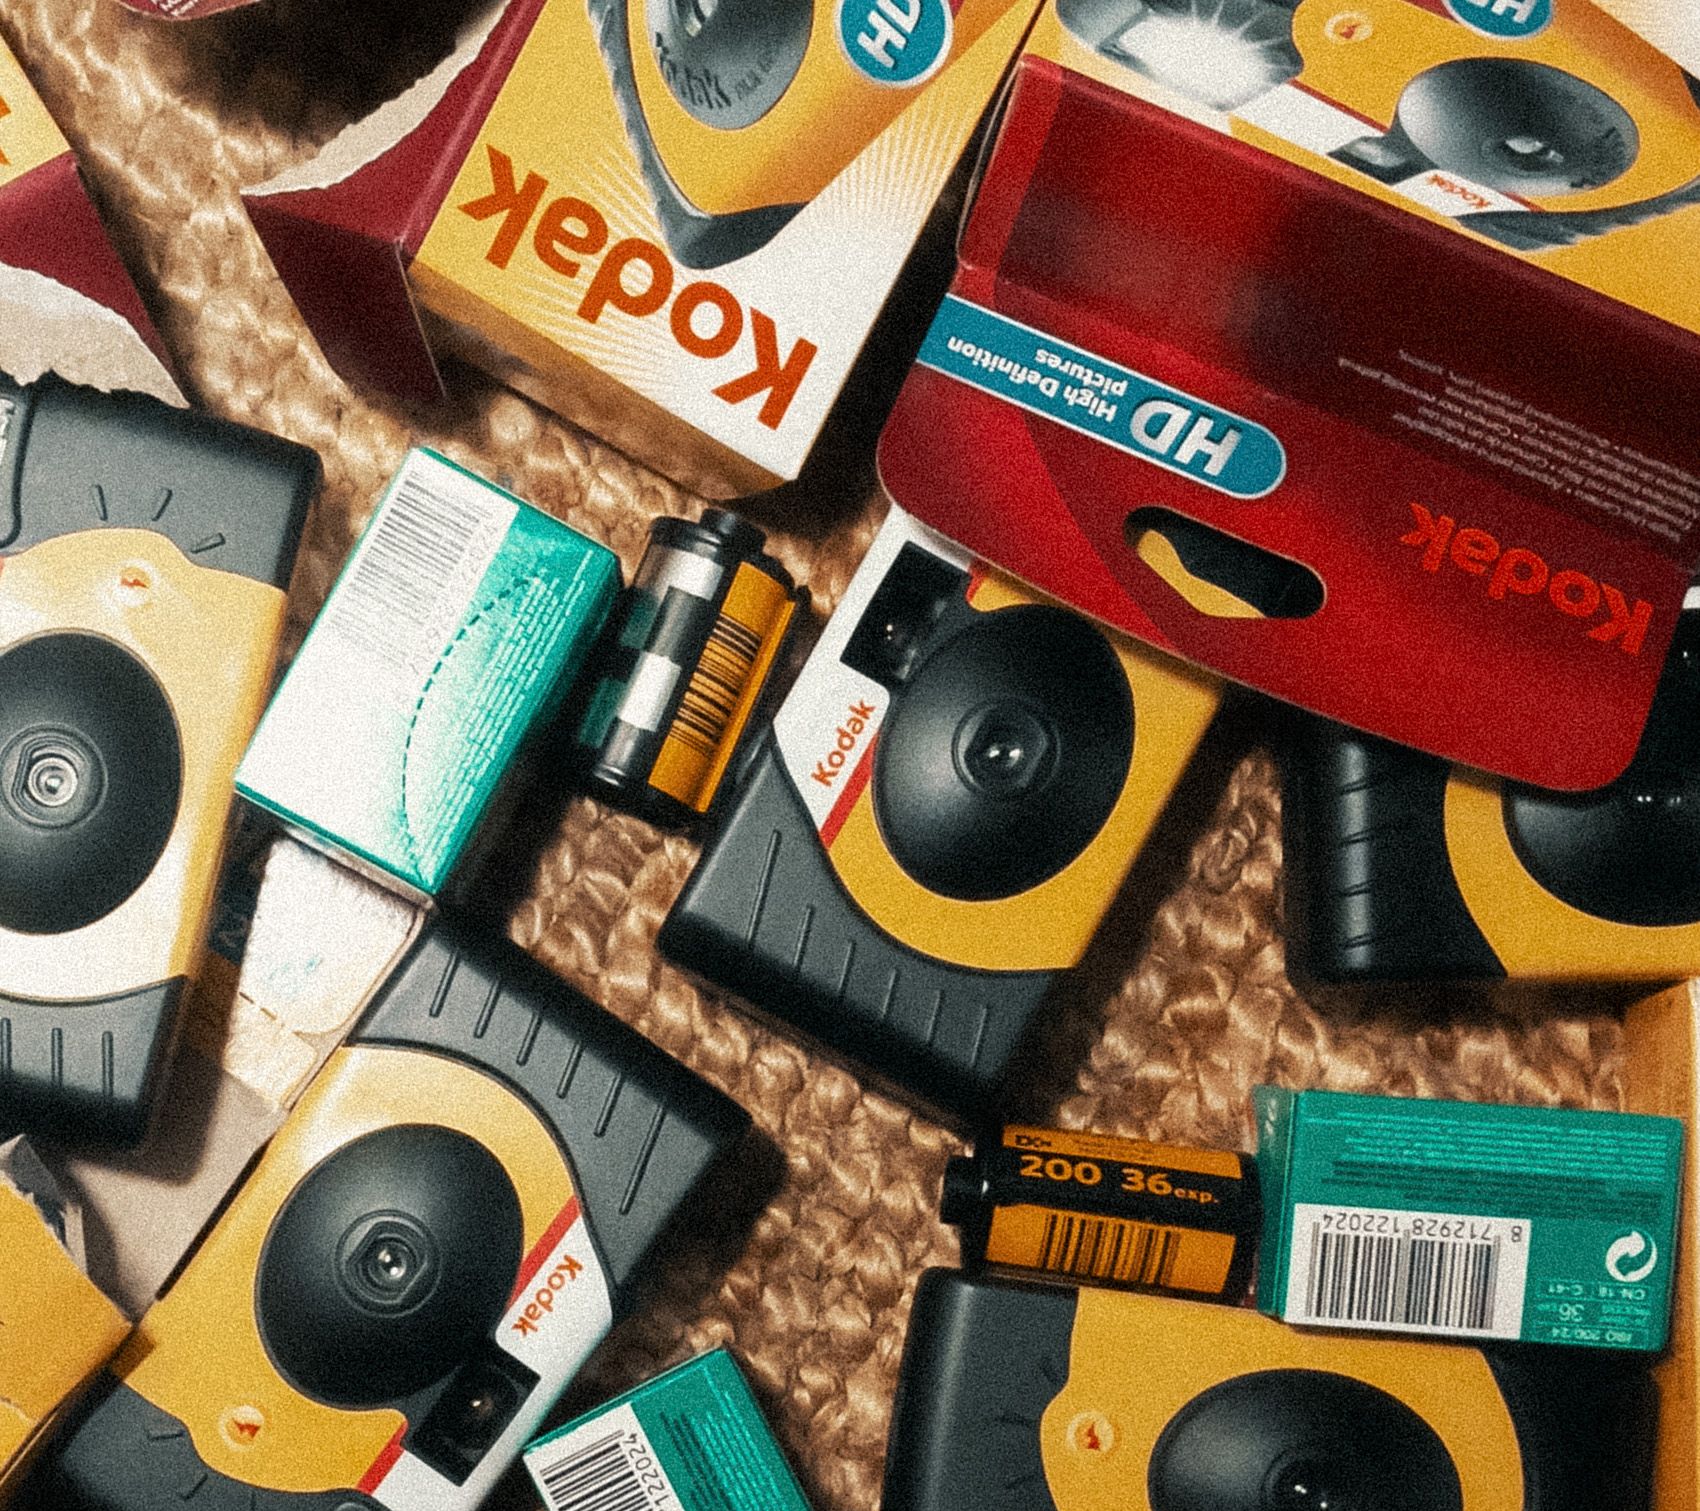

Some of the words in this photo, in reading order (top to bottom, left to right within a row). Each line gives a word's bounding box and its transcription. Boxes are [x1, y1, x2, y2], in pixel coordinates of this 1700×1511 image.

[855, 0, 920, 69] HD
[458, 145, 819, 431] Kodak
[943, 335, 1062, 398] Definition
[1032, 347, 1128, 399] pictures
[1059, 380, 1120, 422] High
[1129, 396, 1244, 479] HD
[1401, 502, 1656, 656] Kodak
[809, 699, 876, 789] Kodak
[1018, 1153, 1103, 1186] 200
[1321, 1211, 1400, 1234] 122024
[1411, 1216, 1491, 1240] 712928
[1510, 1224, 1522, 1241] 8
[511, 1255, 582, 1338] Kodak
[1557, 1302, 1585, 1322] 36
[619, 1430, 673, 1508] 122024
